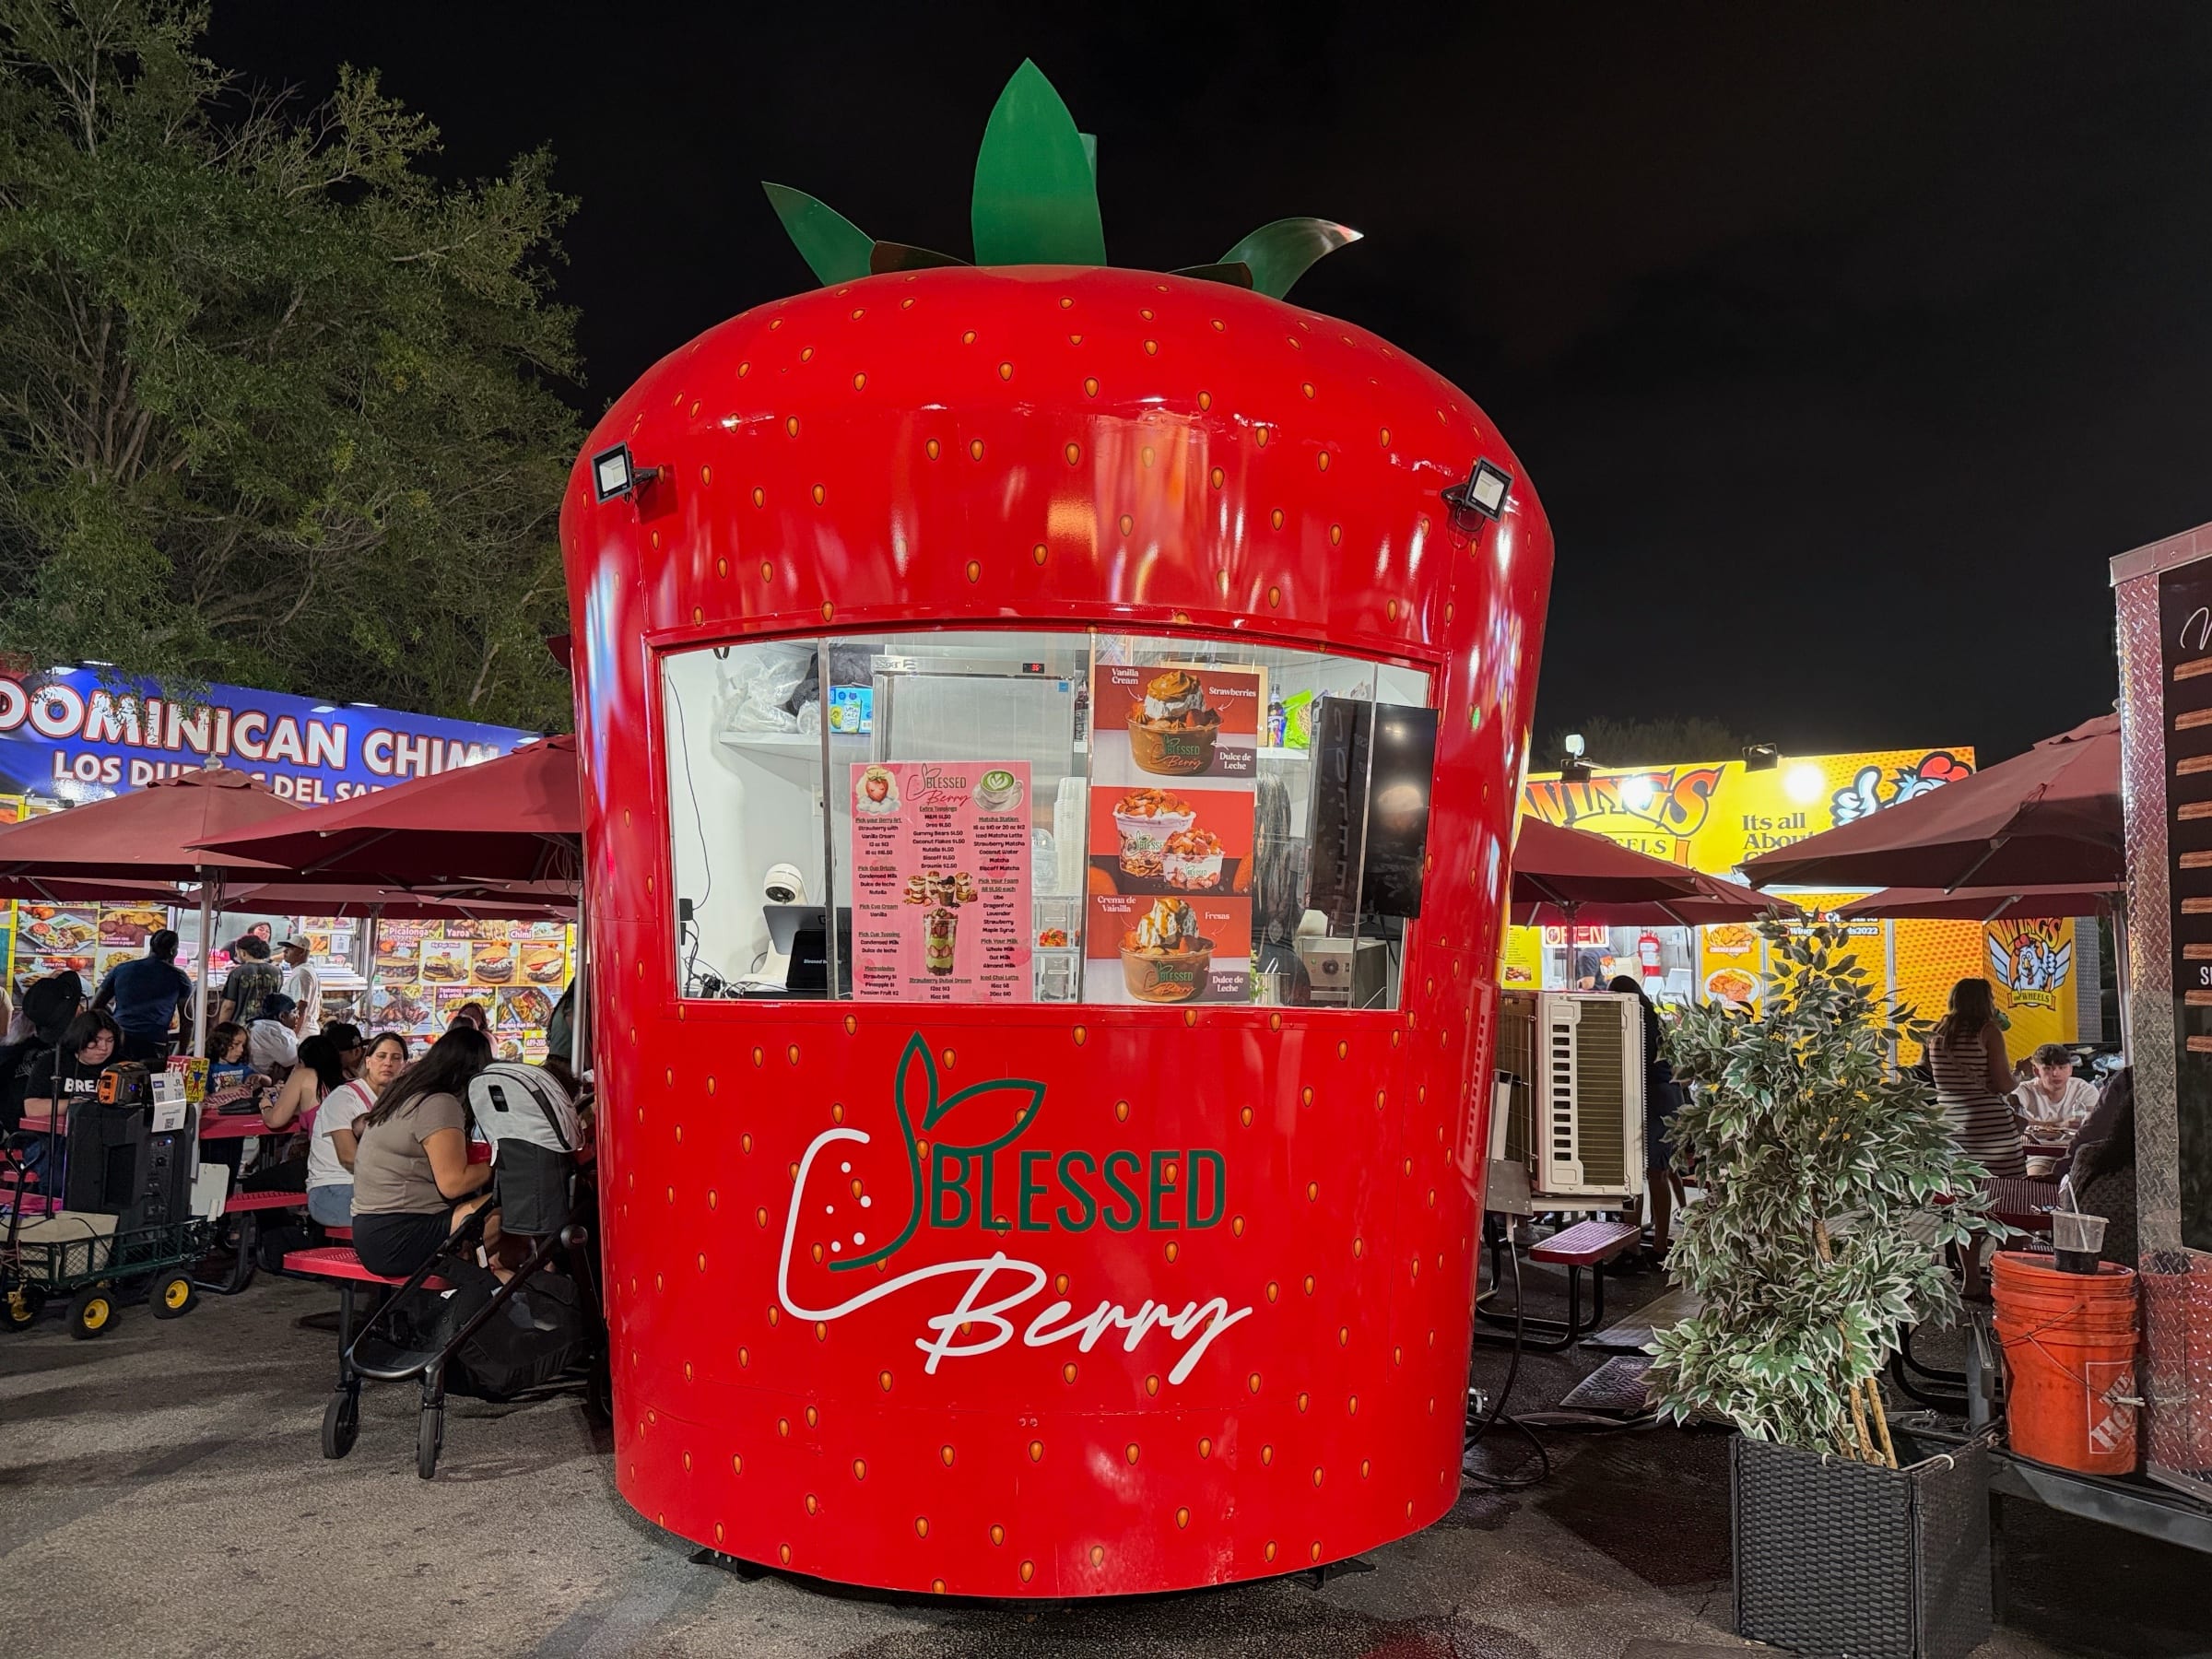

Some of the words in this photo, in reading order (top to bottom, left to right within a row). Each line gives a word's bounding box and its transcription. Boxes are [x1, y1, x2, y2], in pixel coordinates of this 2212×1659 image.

[1112, 668, 1139, 677] Vanilla
[1112, 676, 1139, 684] Cream
[1209, 687, 1256, 697] Strawberries
[1167, 745, 1200, 755] BLESSED
[1219, 752, 1240, 761] Dulce
[1241, 752, 1251, 761] de
[1166, 756, 1203, 770] Berry
[1224, 761, 1247, 770] Leche
[53, 750, 122, 783] LOS
[274, 773, 330, 805] DEL
[926, 777, 966, 788] BLESSED
[927, 790, 971, 807] Berry
[1742, 815, 1773, 831] Its
[1778, 812, 1806, 829] all
[1097, 896, 1125, 905] Crema
[1126, 896, 1136, 904] de
[1102, 904, 1131, 912] Vainilla
[1205, 912, 1230, 920] Fresas
[389, 927, 429, 937] Picalonga
[446, 928, 470, 937] Yaroa
[510, 930, 532, 939] Chimi
[1998, 918, 2063, 948] WINGS
[1160, 972, 1193, 982] BLESSED
[1212, 976, 1233, 984] Dulce
[1217, 984, 1238, 993] Leche
[930, 1147, 1227, 1232] BLESSED
[915, 1252, 1253, 1384] Berry
